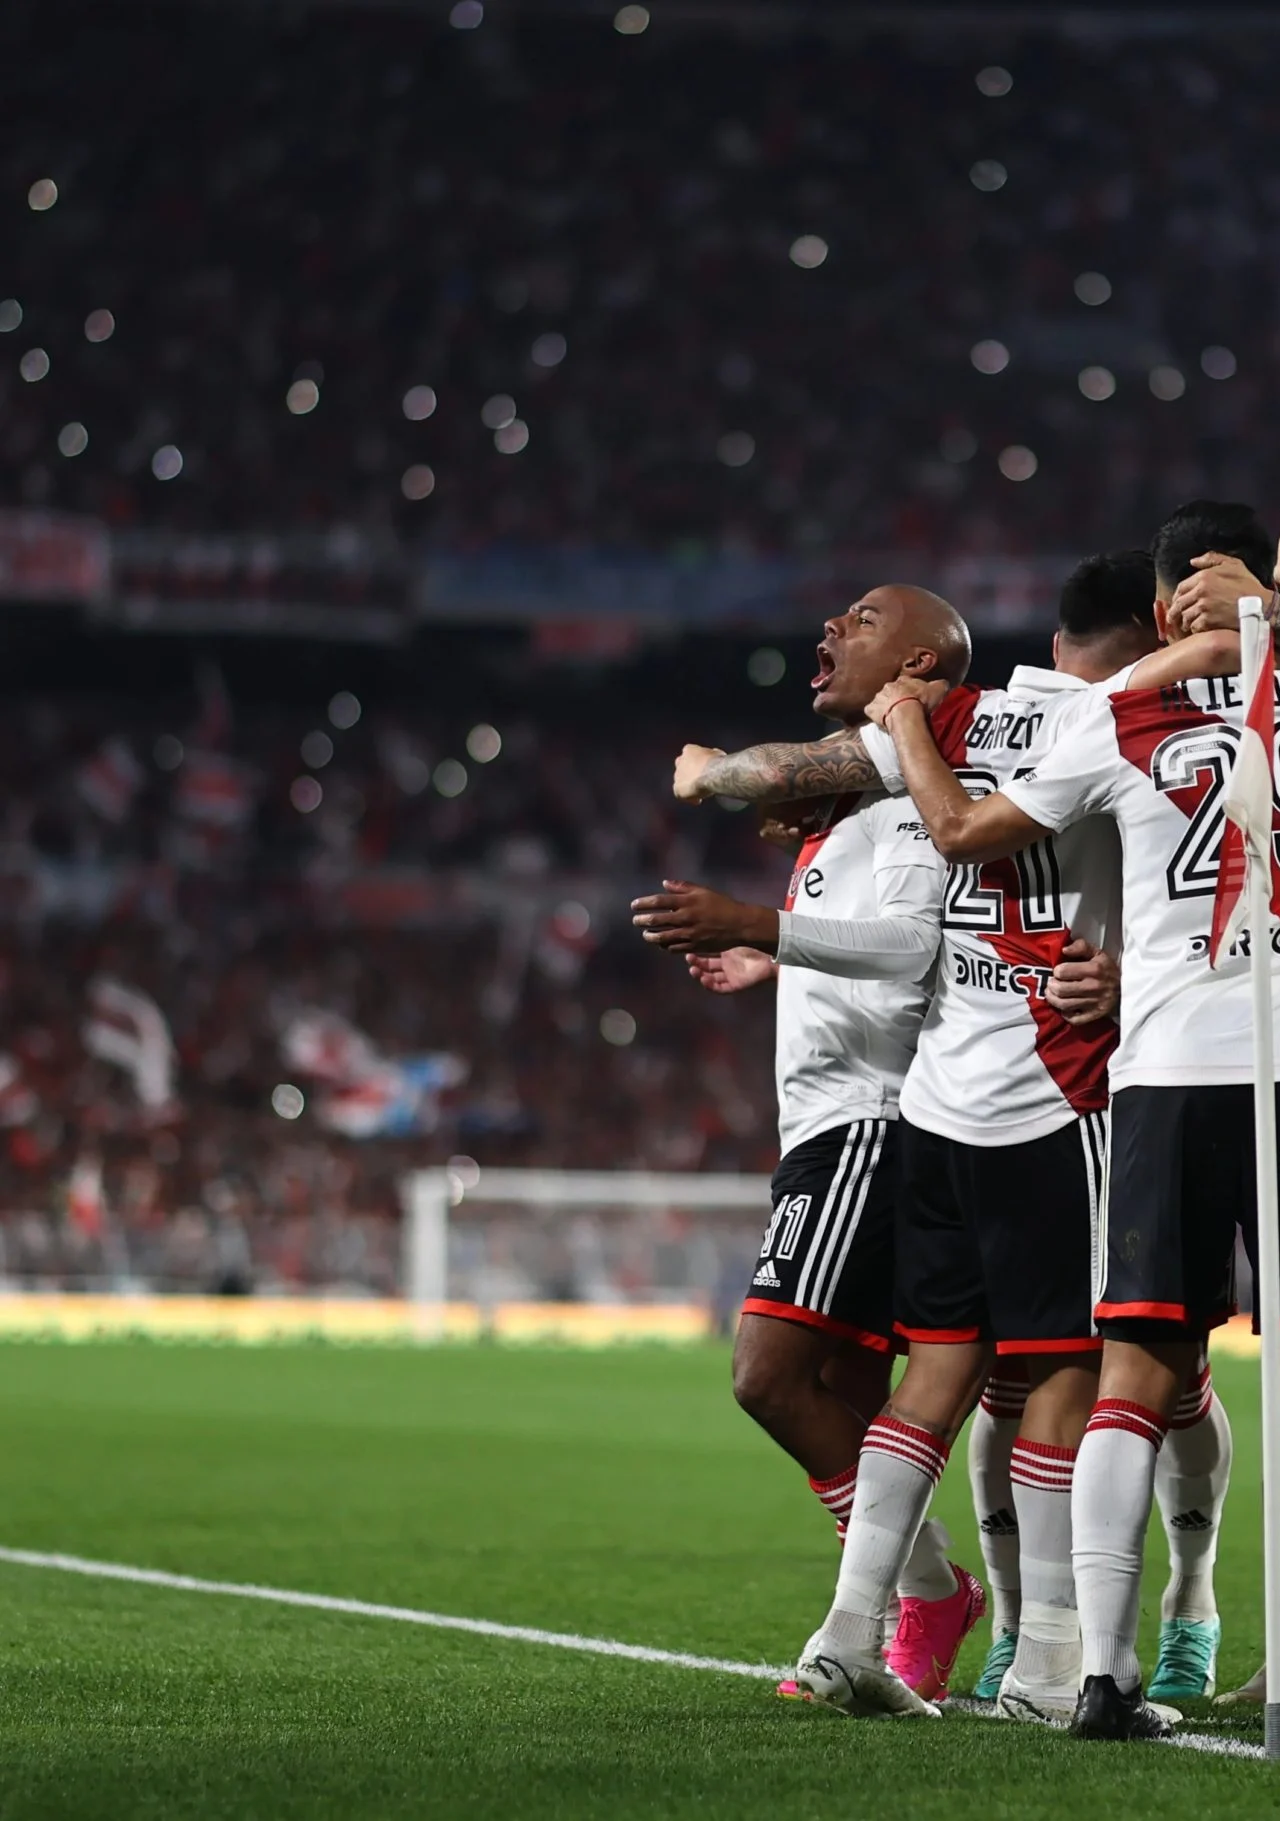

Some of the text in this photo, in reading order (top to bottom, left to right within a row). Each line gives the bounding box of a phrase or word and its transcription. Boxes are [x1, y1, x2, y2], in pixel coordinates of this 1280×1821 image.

[967, 712, 1044, 750] BARCO
[953, 953, 1055, 998] DIRECT
[752, 1277, 782, 1288] adidas
